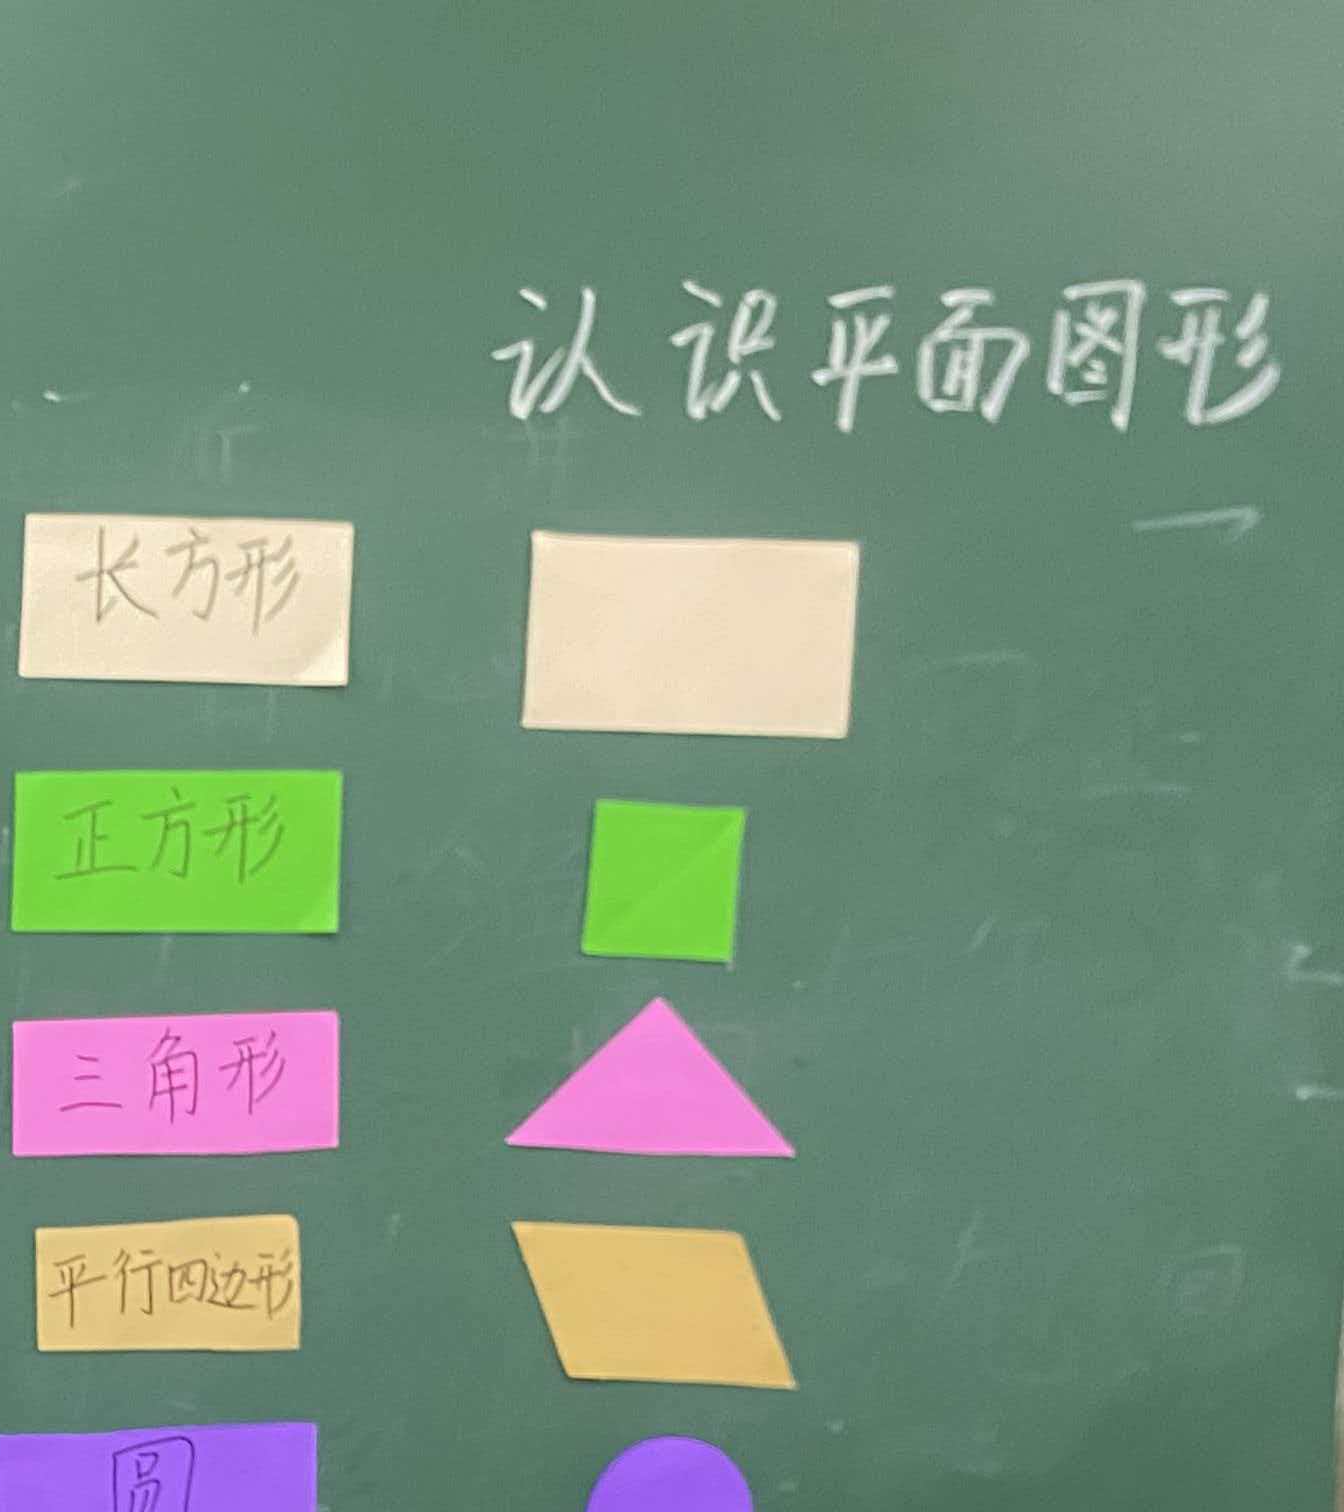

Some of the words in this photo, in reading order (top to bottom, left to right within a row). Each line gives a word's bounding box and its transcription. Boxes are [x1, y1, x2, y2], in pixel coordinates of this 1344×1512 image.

[493, 280, 1282, 435] 认识平面图形
[75, 525, 300, 636] 长方形
[55, 786, 285, 884] 正方形
[59, 1027, 286, 1124] 三角形
[47, 1248, 294, 1328] 平行四边形
